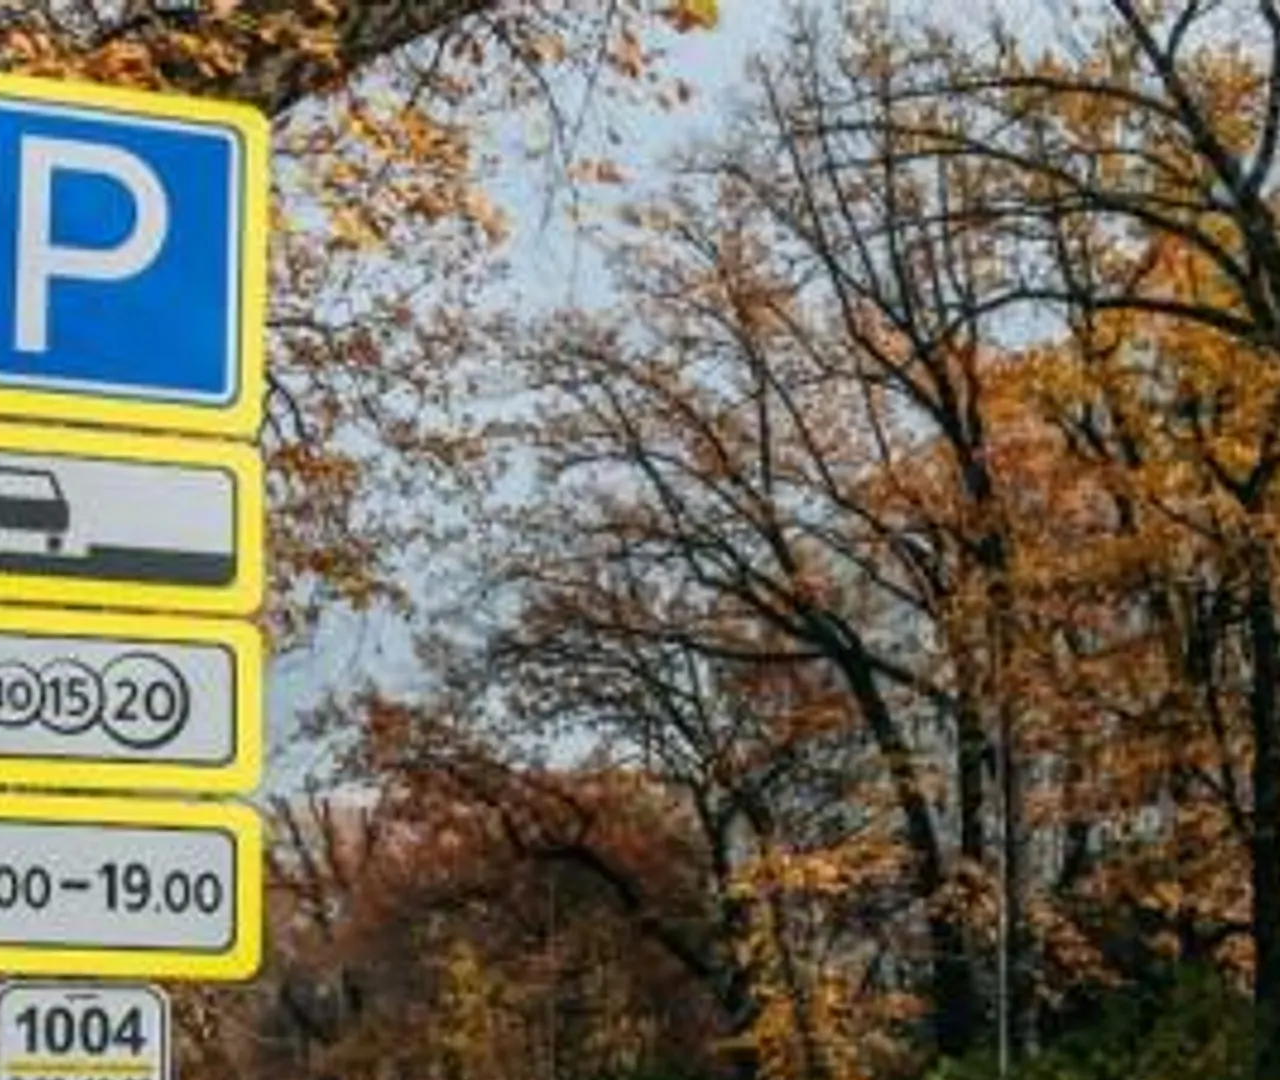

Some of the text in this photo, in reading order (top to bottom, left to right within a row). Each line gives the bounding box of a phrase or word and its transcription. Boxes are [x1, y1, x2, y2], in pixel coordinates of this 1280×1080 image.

[14, 134, 169, 351] P
[48, 677, 90, 715] 15
[113, 680, 176, 723] 20
[16, 1005, 147, 1057] 1004
